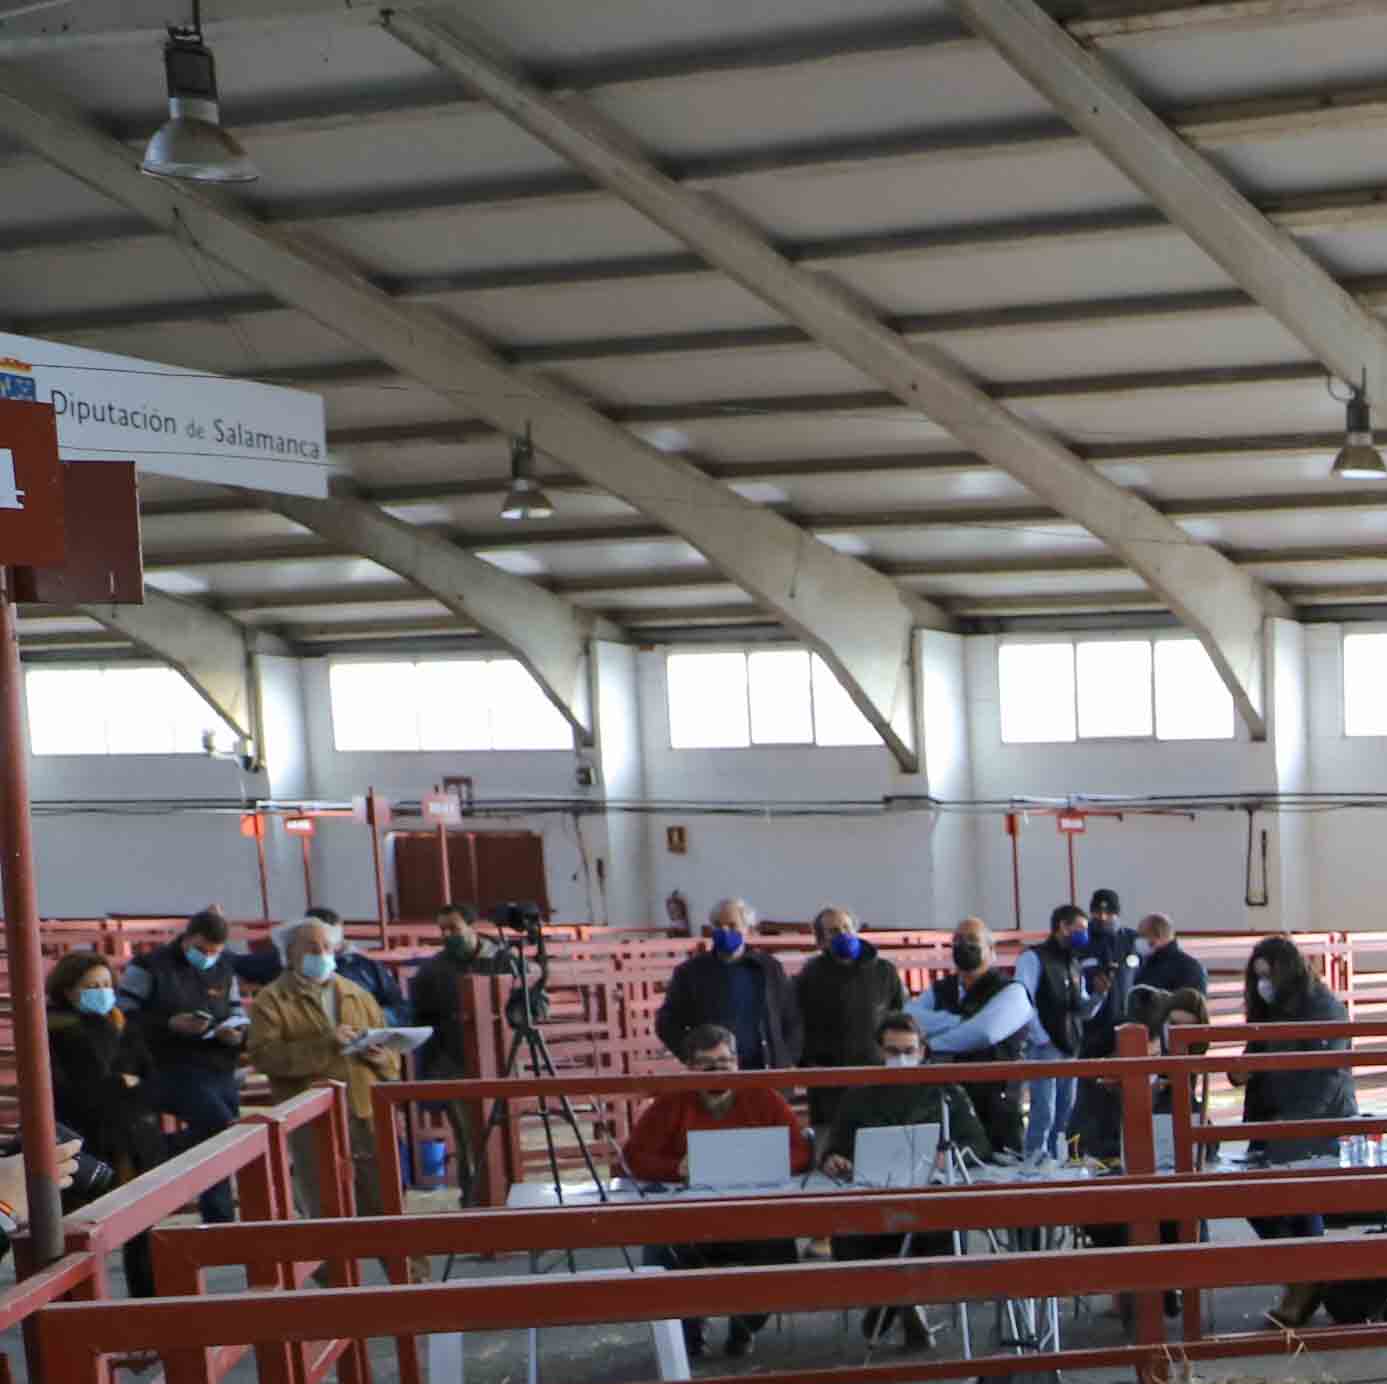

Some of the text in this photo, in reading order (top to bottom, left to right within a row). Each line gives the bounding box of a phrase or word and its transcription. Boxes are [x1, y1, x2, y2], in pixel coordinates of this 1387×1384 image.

[50, 389, 321, 459] Diputación de Salamanca
